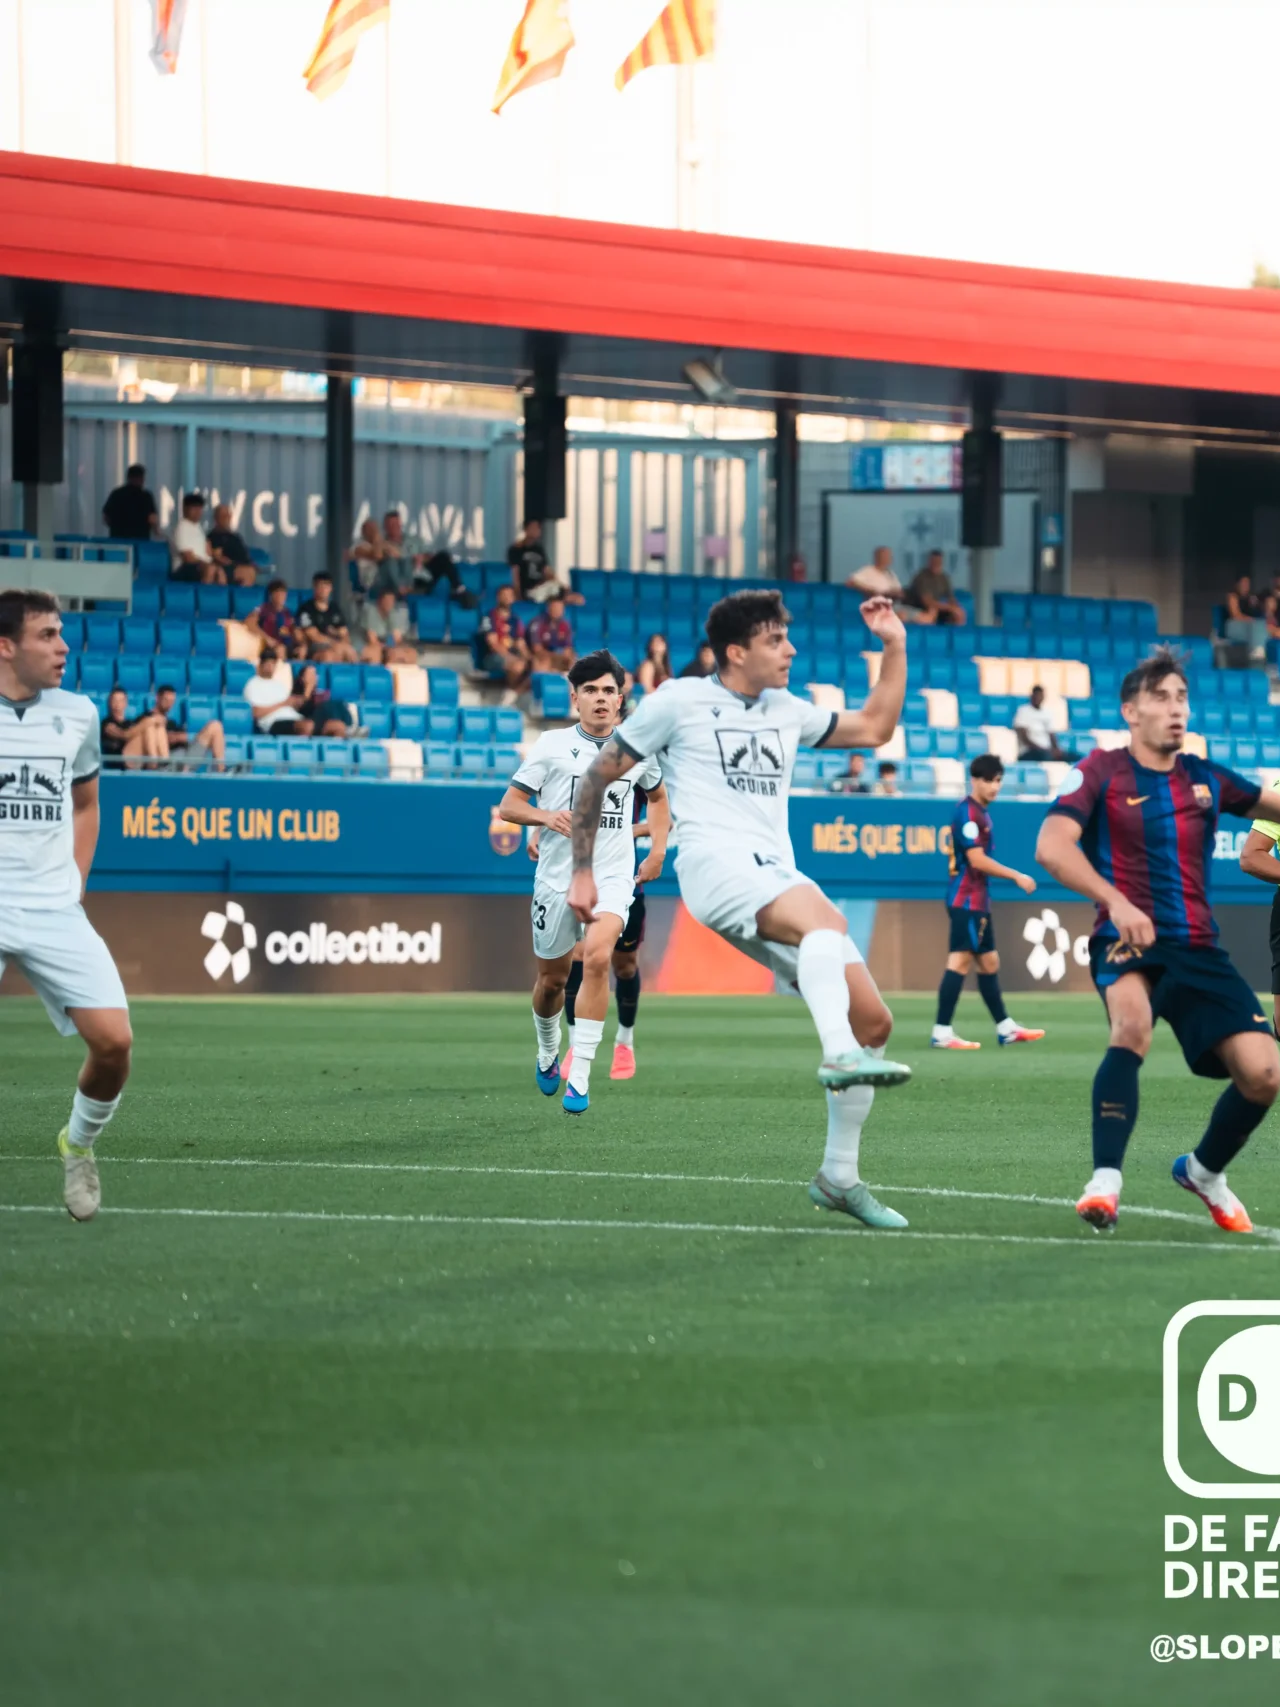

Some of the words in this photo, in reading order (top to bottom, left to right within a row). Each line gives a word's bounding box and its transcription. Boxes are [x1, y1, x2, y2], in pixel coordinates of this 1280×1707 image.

[727, 777, 779, 796] AGUIRR
[122, 797, 177, 839] MÉS
[181, 807, 233, 846] QUE
[237, 808, 273, 841] UN
[278, 808, 341, 842] CLUB
[812, 816, 858, 853] MÉS
[860, 825, 904, 859] QUE
[905, 824, 937, 854] UN
[265, 922, 442, 965] collectibol
